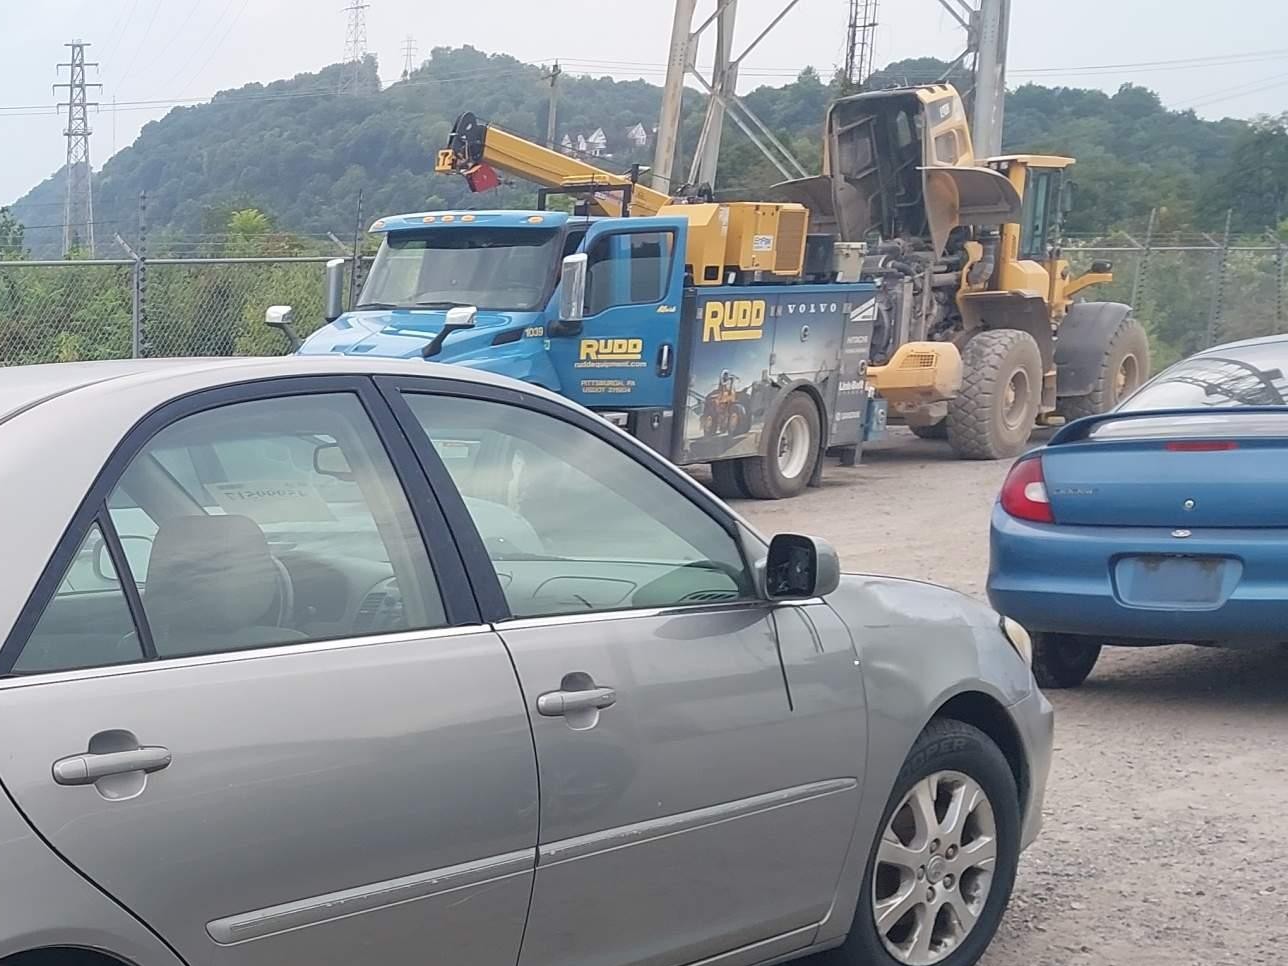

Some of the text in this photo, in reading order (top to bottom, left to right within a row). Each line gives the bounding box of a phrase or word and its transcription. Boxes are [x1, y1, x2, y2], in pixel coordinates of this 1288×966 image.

[702, 300, 766, 343] RUDD
[787, 303, 838, 314] VOLVO
[579, 338, 643, 360] RUDD
[900, 739, 967, 778] OOPER
